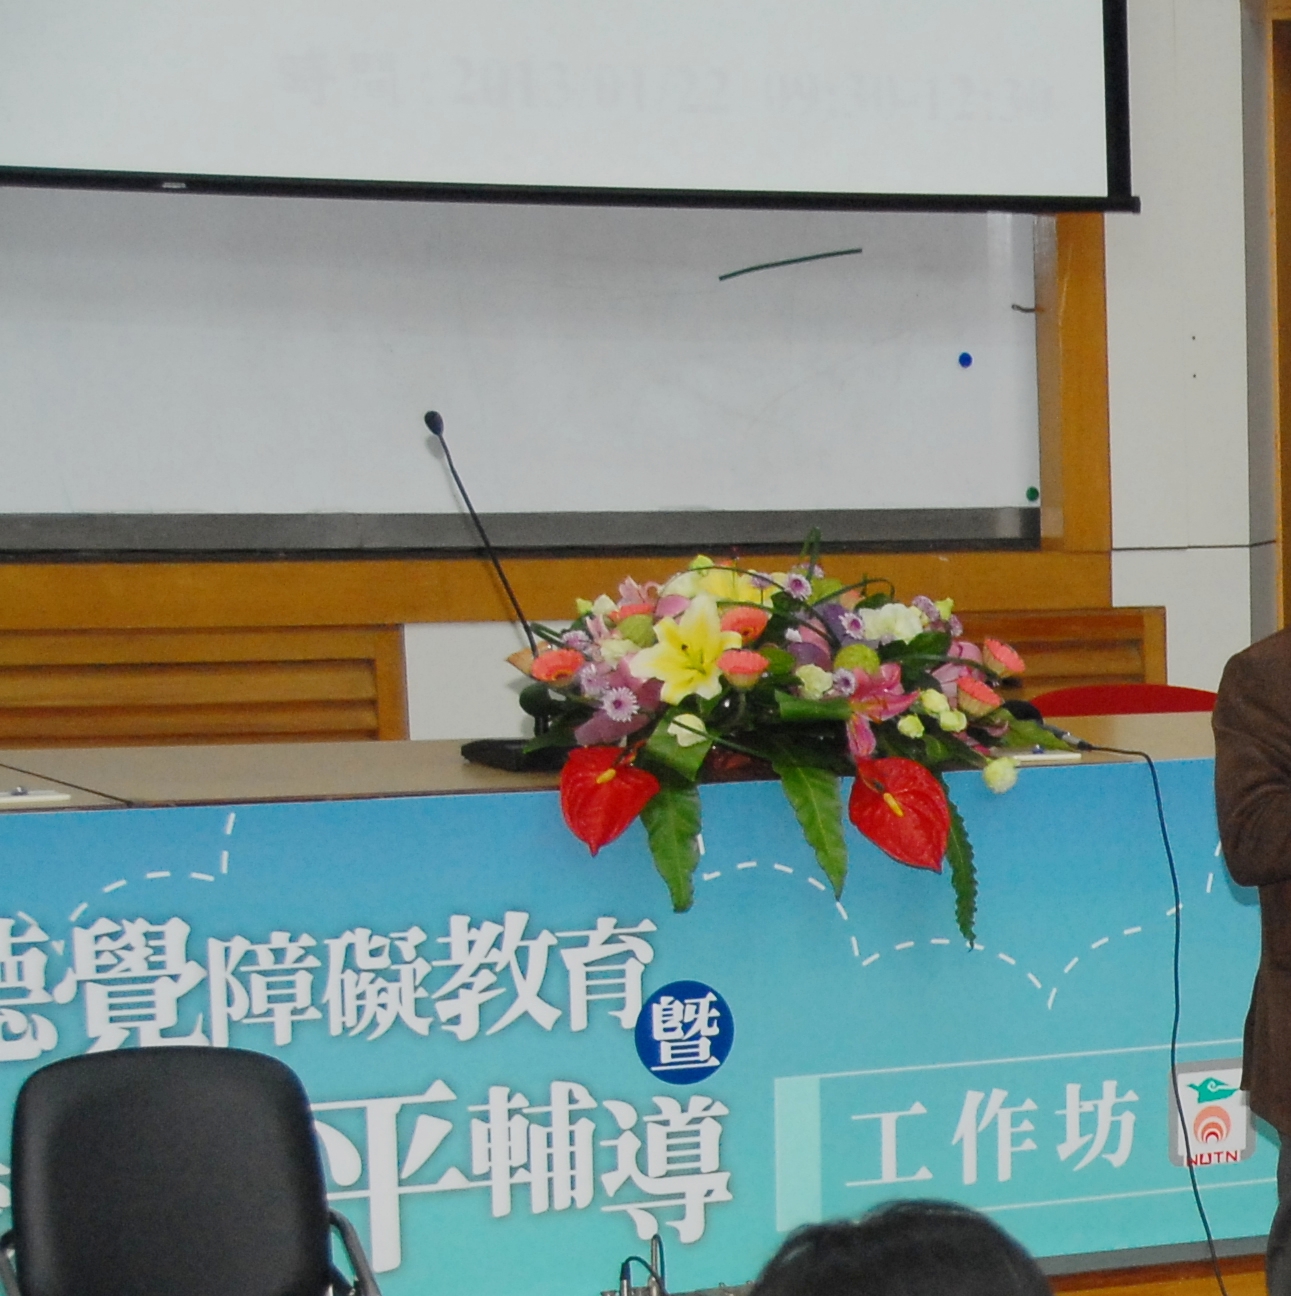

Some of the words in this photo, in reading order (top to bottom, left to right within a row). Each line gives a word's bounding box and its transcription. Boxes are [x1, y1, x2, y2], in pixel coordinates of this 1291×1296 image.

[650, 991, 721, 1071] 暨
[845, 1079, 1140, 1187] 工作坊
[1187, 1150, 1239, 1167] NUTN
